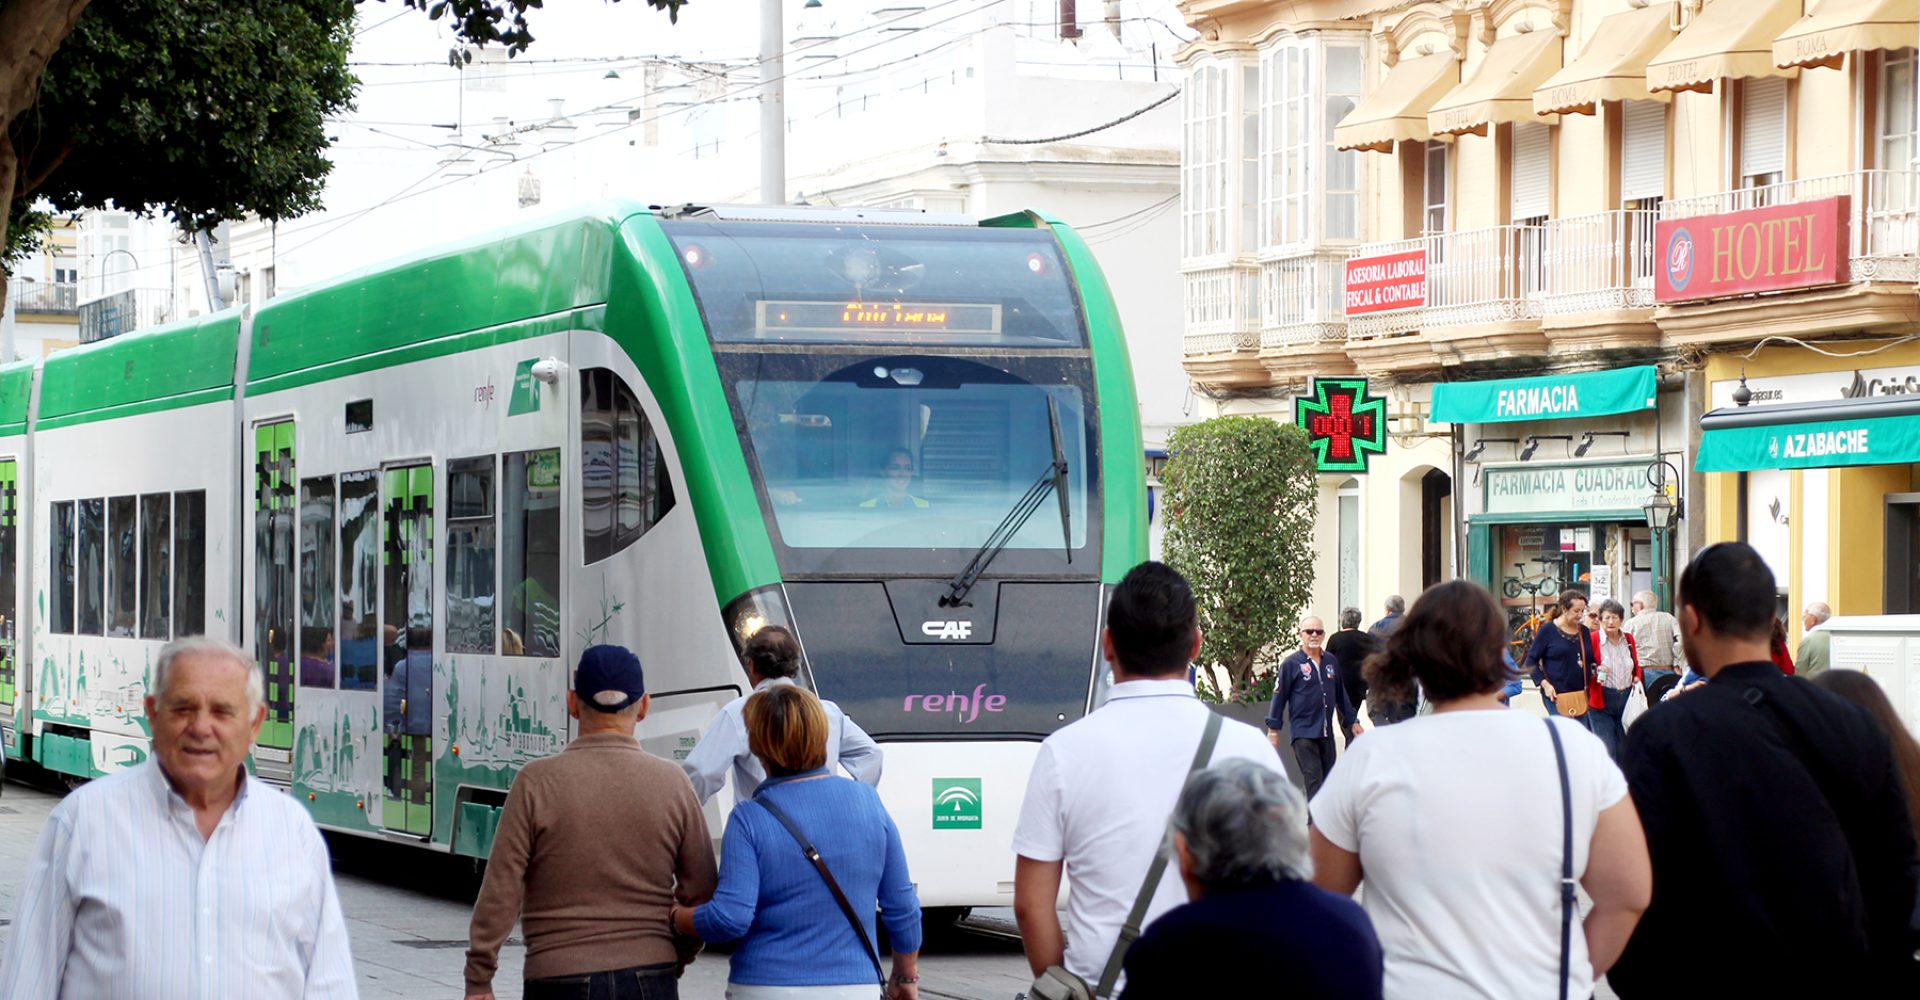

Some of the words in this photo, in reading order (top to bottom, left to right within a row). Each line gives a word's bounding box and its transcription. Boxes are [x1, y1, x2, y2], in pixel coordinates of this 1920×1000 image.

[1710, 214, 1825, 283] HOTEL
[1347, 264, 1386, 286] ASESORIA
[1387, 258, 1425, 280] LABORAL
[1346, 288, 1373, 308] FISCAL
[1382, 281, 1425, 303] CONTABLE
[474, 375, 495, 411] renfe
[1497, 384, 1579, 417] FARMACIA
[1783, 429, 1868, 459] AZABACHE
[1493, 471, 1566, 497] FARMACIA
[921, 621, 972, 640] CAF
[903, 682, 1007, 724] renfe
